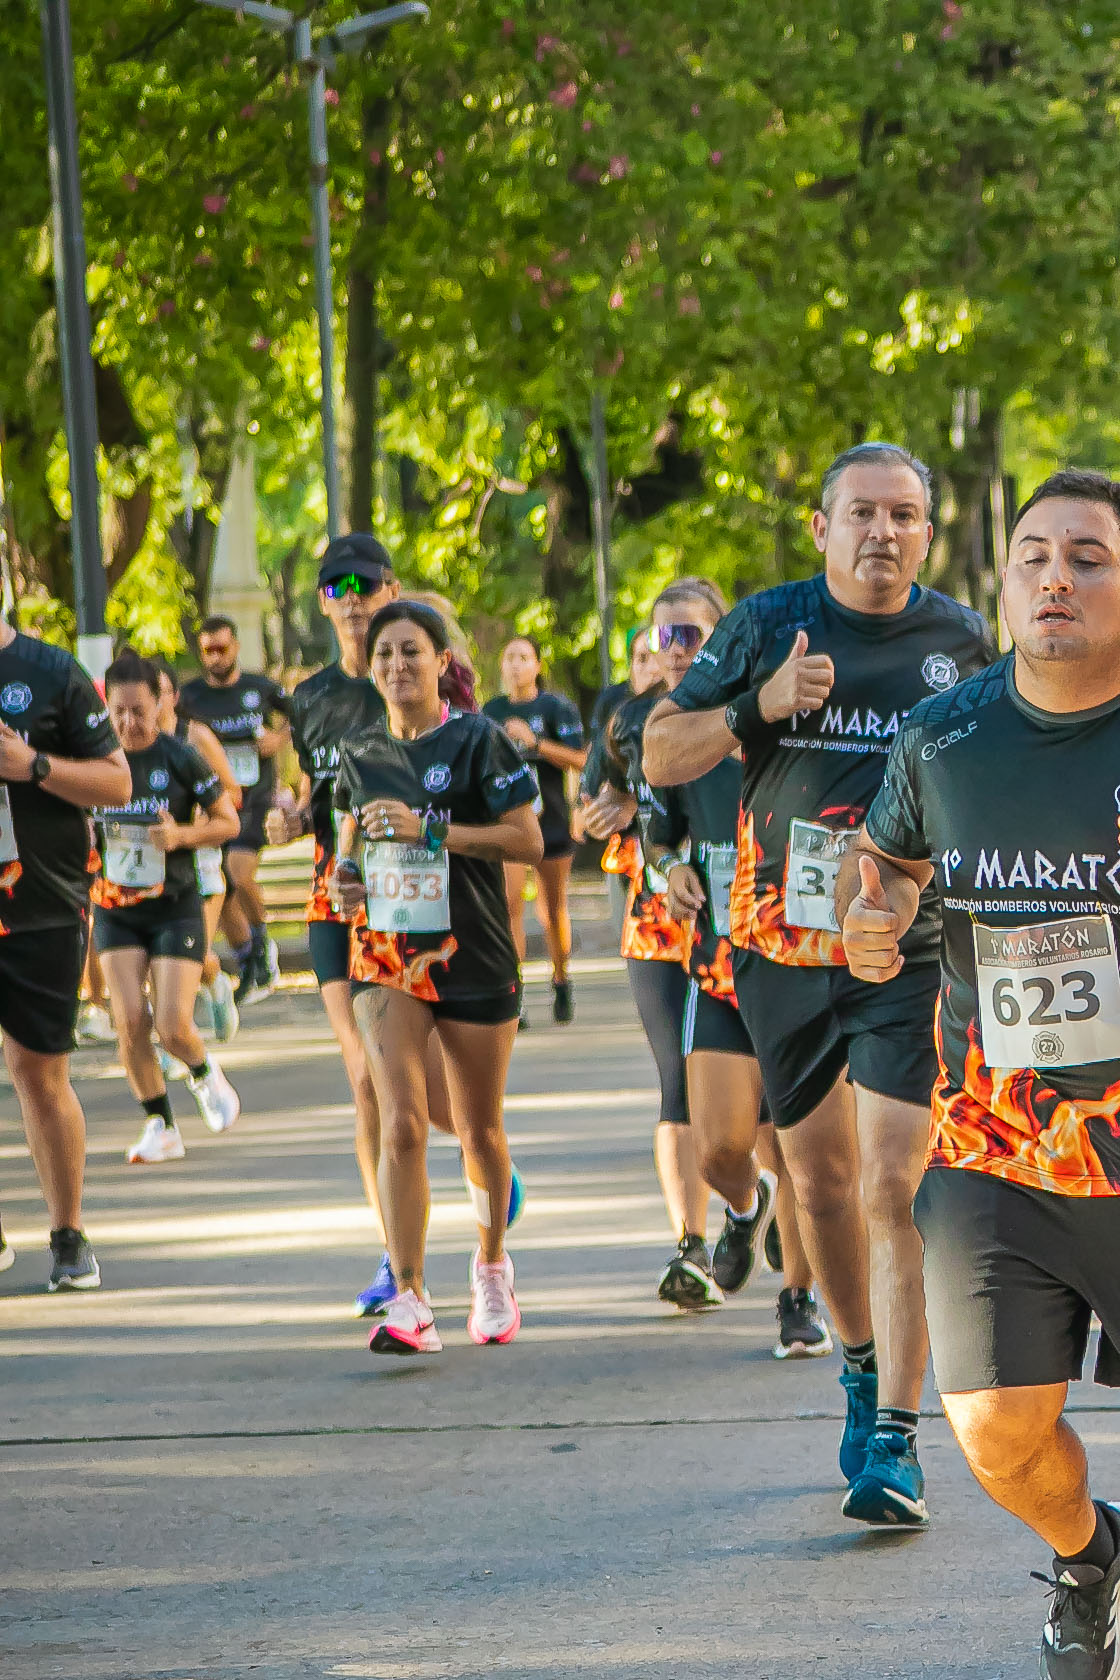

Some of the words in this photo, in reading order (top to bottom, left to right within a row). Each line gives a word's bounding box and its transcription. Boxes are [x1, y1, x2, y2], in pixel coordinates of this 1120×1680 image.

[820, 704, 909, 738] MARA
[823, 741, 869, 752] BOMBEROS
[941, 848, 962, 888] 1º
[369, 872, 443, 902] 1053
[984, 899, 1047, 914] BOMBEROS
[1002, 925, 1090, 957] MARATÓN
[1038, 951, 1080, 966] VOLUNTARIOS
[1081, 946, 1108, 958] ROSARIO
[992, 970, 1101, 1027] 623
